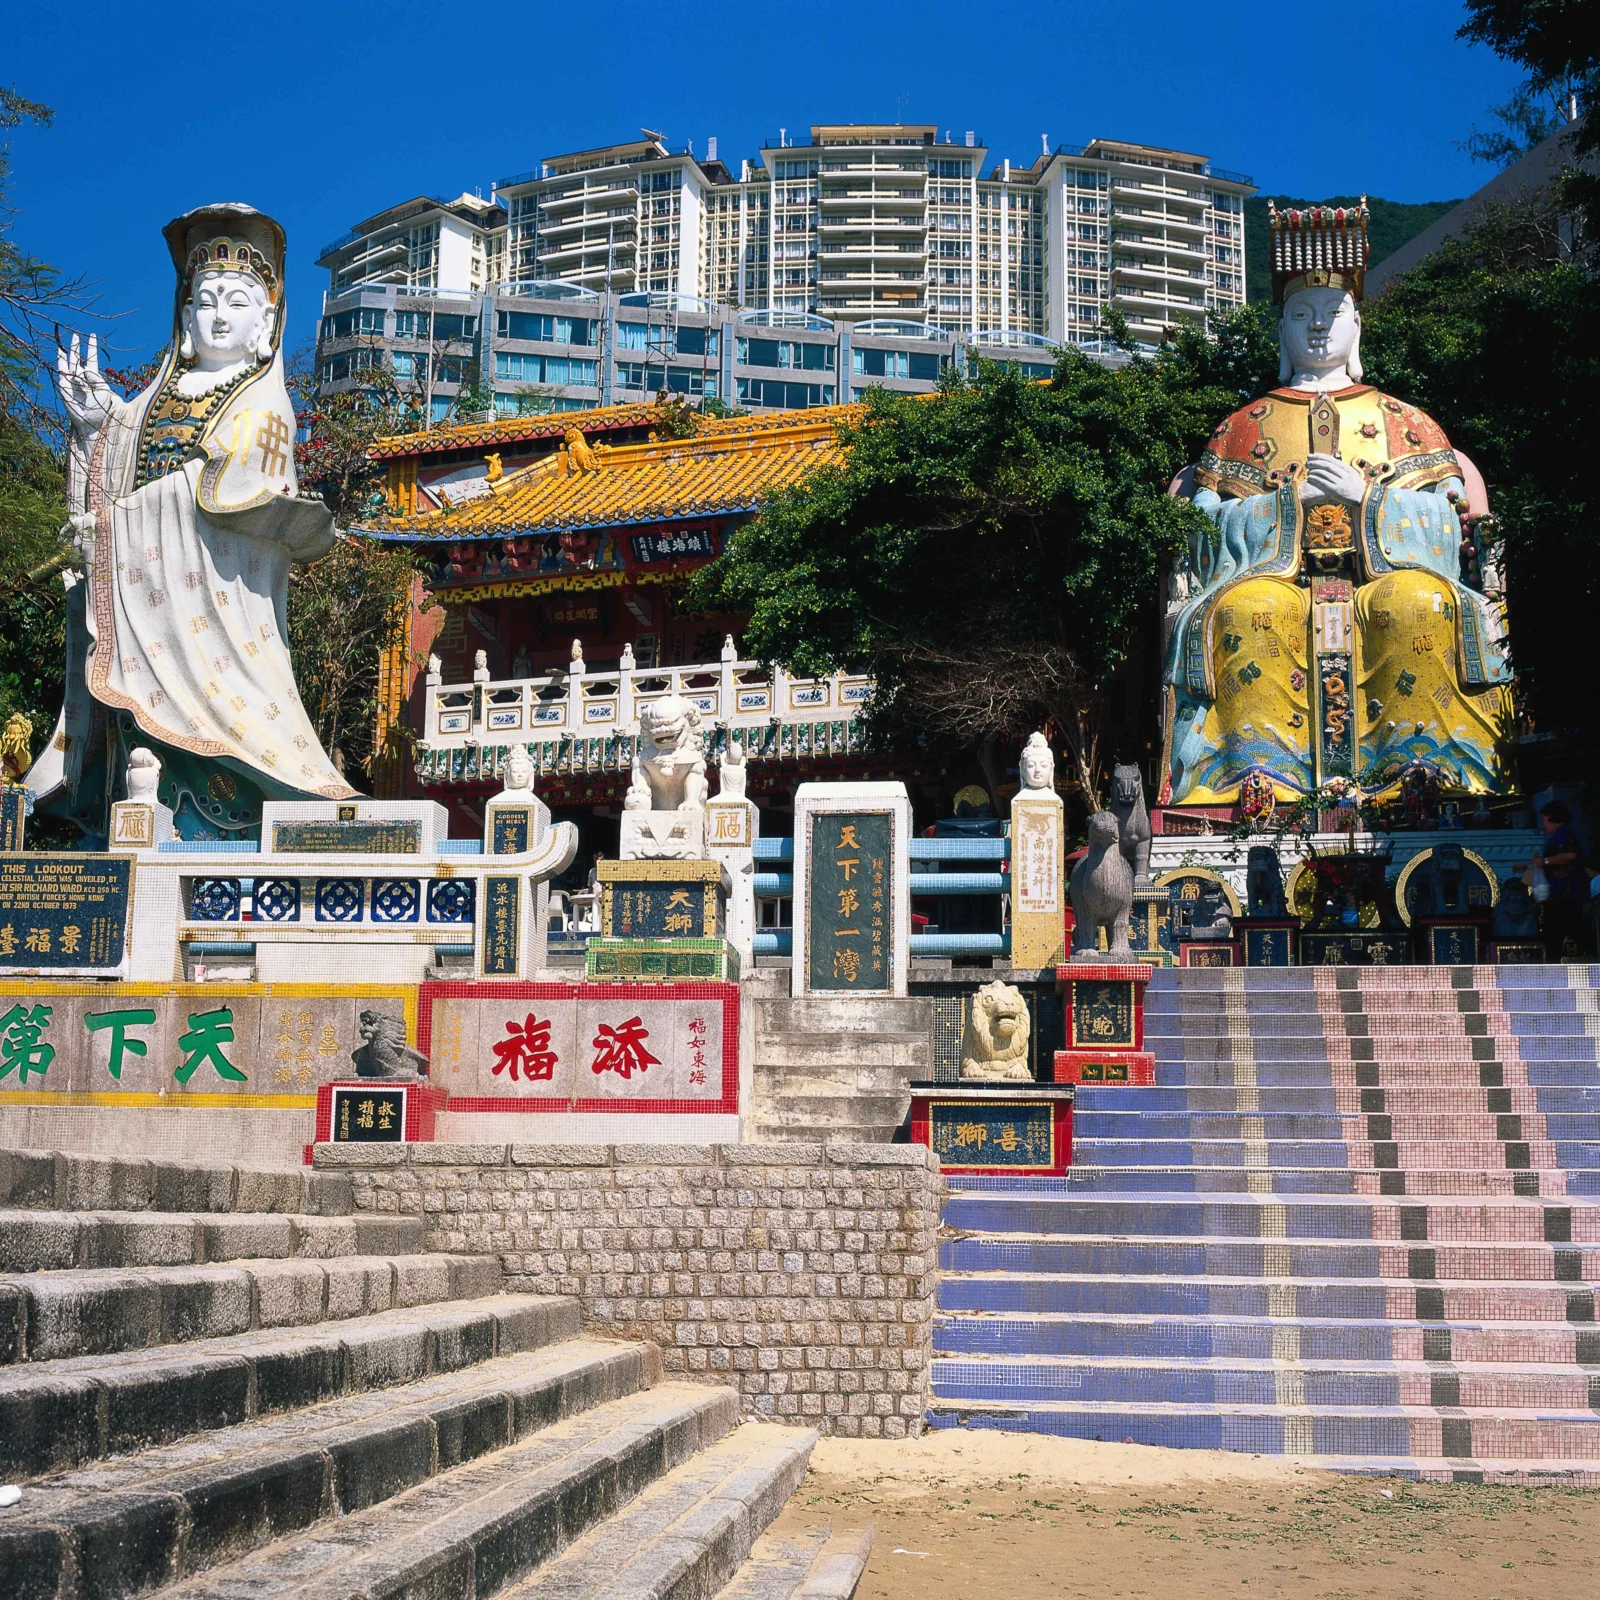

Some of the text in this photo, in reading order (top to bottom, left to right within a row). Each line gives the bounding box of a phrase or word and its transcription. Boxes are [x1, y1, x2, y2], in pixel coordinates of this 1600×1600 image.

[1251, 611, 1273, 631] 福
[1412, 632, 1434, 654] 福
[1, 875, 118, 884] CELESTIAL LIONS WAS UNVEILED BY
[2, 864, 84, 874] THIS LOOKOUT
[1032, 837, 1046, 897] 南海之神
[9, 884, 23, 893] SIR
[23, 883, 59, 893] RICHARD
[60, 884, 83, 893] WARD
[16, 893, 40, 901] BRITISH
[42, 893, 67, 901] FORCES
[69, 894, 86, 902] HONG
[88, 894, 105, 902] KONG
[13, 901, 30, 909] 22ND
[32, 902, 60, 910] OCTOBER
[62, 902, 77, 910] 1973
[662, 888, 696, 935] 天獅
[834, 824, 861, 982] 天下第一灣
[0, 1003, 249, 1086] 天下第
[491, 1012, 662, 1082] 添福
[688, 1017, 708, 1086] 福如東海
[954, 1120, 1022, 1152] 喜獅
